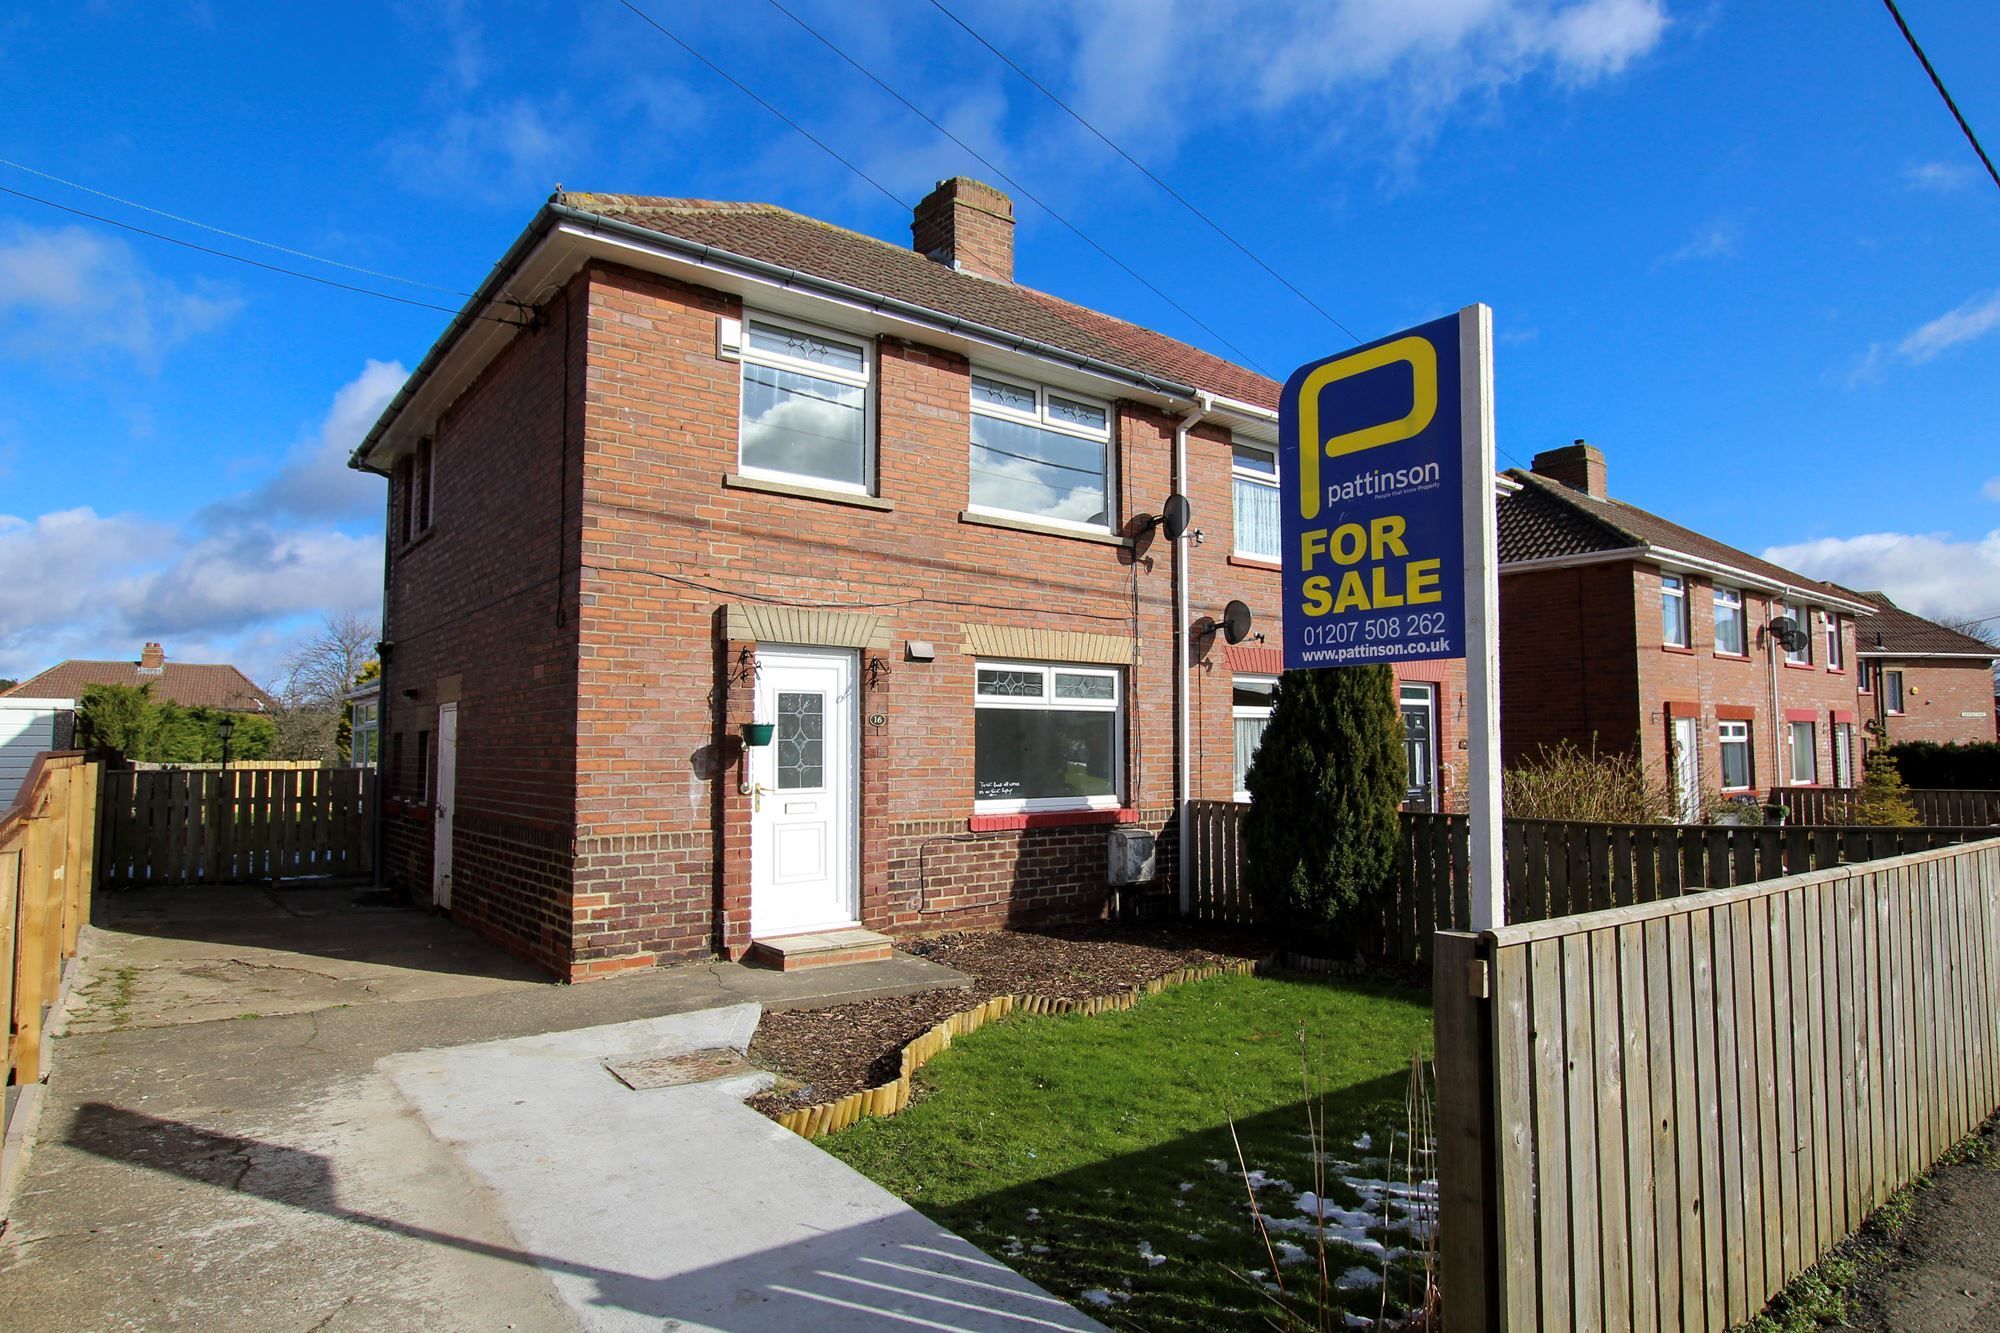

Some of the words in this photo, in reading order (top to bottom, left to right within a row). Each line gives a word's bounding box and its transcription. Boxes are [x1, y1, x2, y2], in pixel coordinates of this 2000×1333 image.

[1328, 462, 1440, 508] pattinson
[1417, 482, 1440, 491] Property
[1302, 516, 1408, 571] FOR
[1301, 558, 1442, 617] SALE
[1304, 622, 1359, 646] 01207
[1364, 618, 1401, 640] 508
[1406, 612, 1446, 636] 262
[1301, 637, 1450, 662] www.pattinson.co.uk
[874, 716, 882, 724] 16
